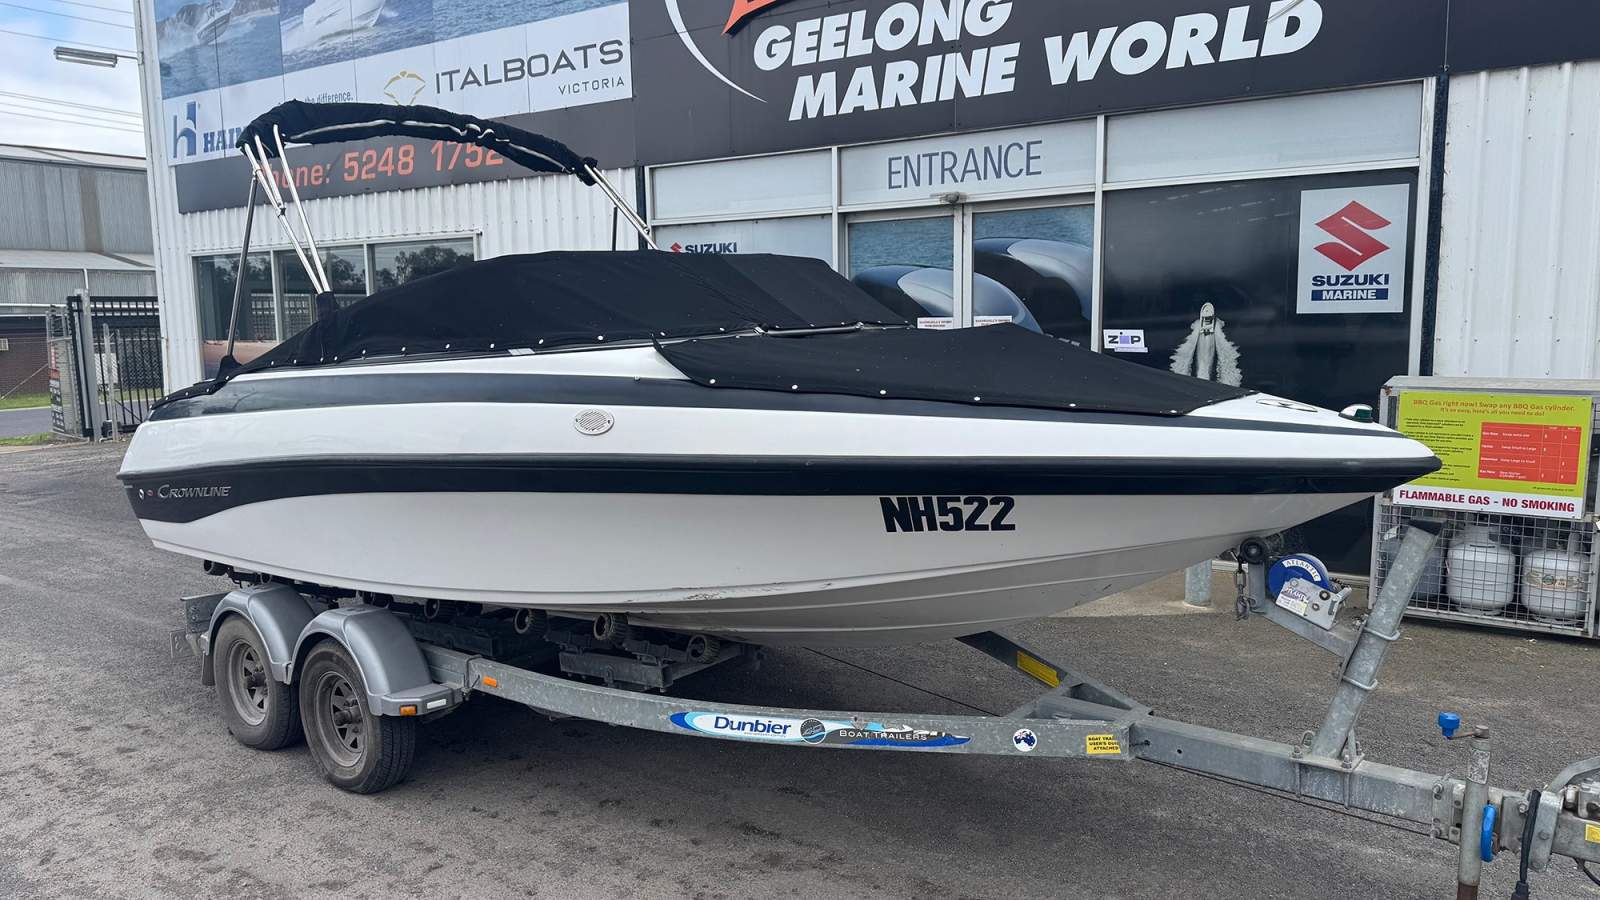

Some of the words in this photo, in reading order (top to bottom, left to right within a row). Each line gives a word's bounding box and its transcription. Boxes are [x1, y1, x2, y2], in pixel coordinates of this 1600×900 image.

[753, 0, 1013, 71] GEELONG
[435, 39, 624, 94] ITALBOATS
[788, 42, 1021, 121] MARINE
[1043, 0, 1323, 86] WORLD
[316, 91, 353, 104] difference.
[558, 76, 625, 95] VICTORIA
[343, 144, 415, 182] 5248
[888, 140, 1043, 190] ENTRANCE
[685, 242, 737, 254] SUZUKI
[1311, 274, 1390, 287] SUZUKI
[1322, 289, 1377, 300] MARINE
[1399, 489, 1465, 504] FLAMMABLE
[1468, 495, 1490, 506] GAS
[1502, 497, 1518, 508] NO
[1521, 499, 1575, 512] SMOKING
[879, 496, 1016, 532] NH522
[714, 716, 792, 735] Dunbier
[839, 729, 868, 738] BOAT
[873, 731, 928, 741] TRAILERS
